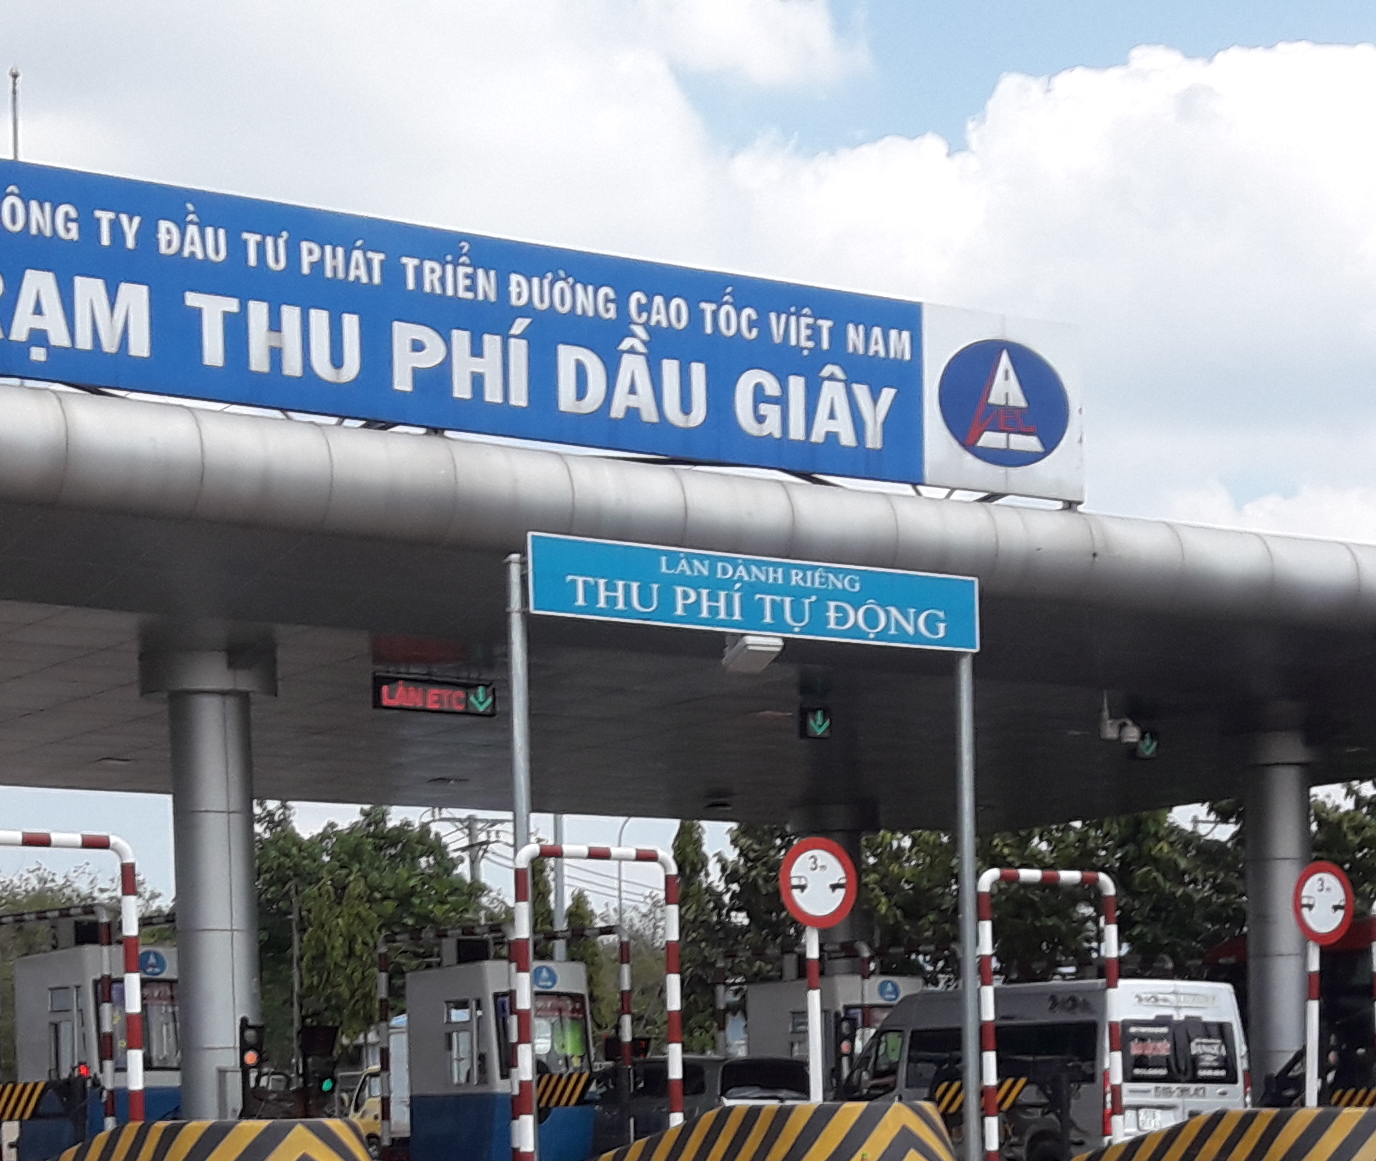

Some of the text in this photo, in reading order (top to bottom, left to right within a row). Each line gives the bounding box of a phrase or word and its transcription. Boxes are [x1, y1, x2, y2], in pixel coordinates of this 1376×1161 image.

[93, 209, 142, 250] TY
[156, 202, 227, 263] ĐẦU
[241, 230, 289, 271] TƯ
[299, 238, 386, 286] PHÁT
[508, 268, 617, 320] ĐƯỜNG
[628, 290, 690, 331] CAO
[699, 286, 759, 341] TỐC
[846, 322, 912, 361] NAM
[184, 291, 362, 384] THU
[391, 317, 532, 408] PHÍ
[556, 323, 707, 428] DẦU
[734, 363, 898, 450] GIÂY
[660, 553, 861, 593] LÀN DÀNH RIÊNG
[566, 574, 948, 640] THU PHÍ TỰ ĐỘNG
[426, 688, 466, 710] ETC
